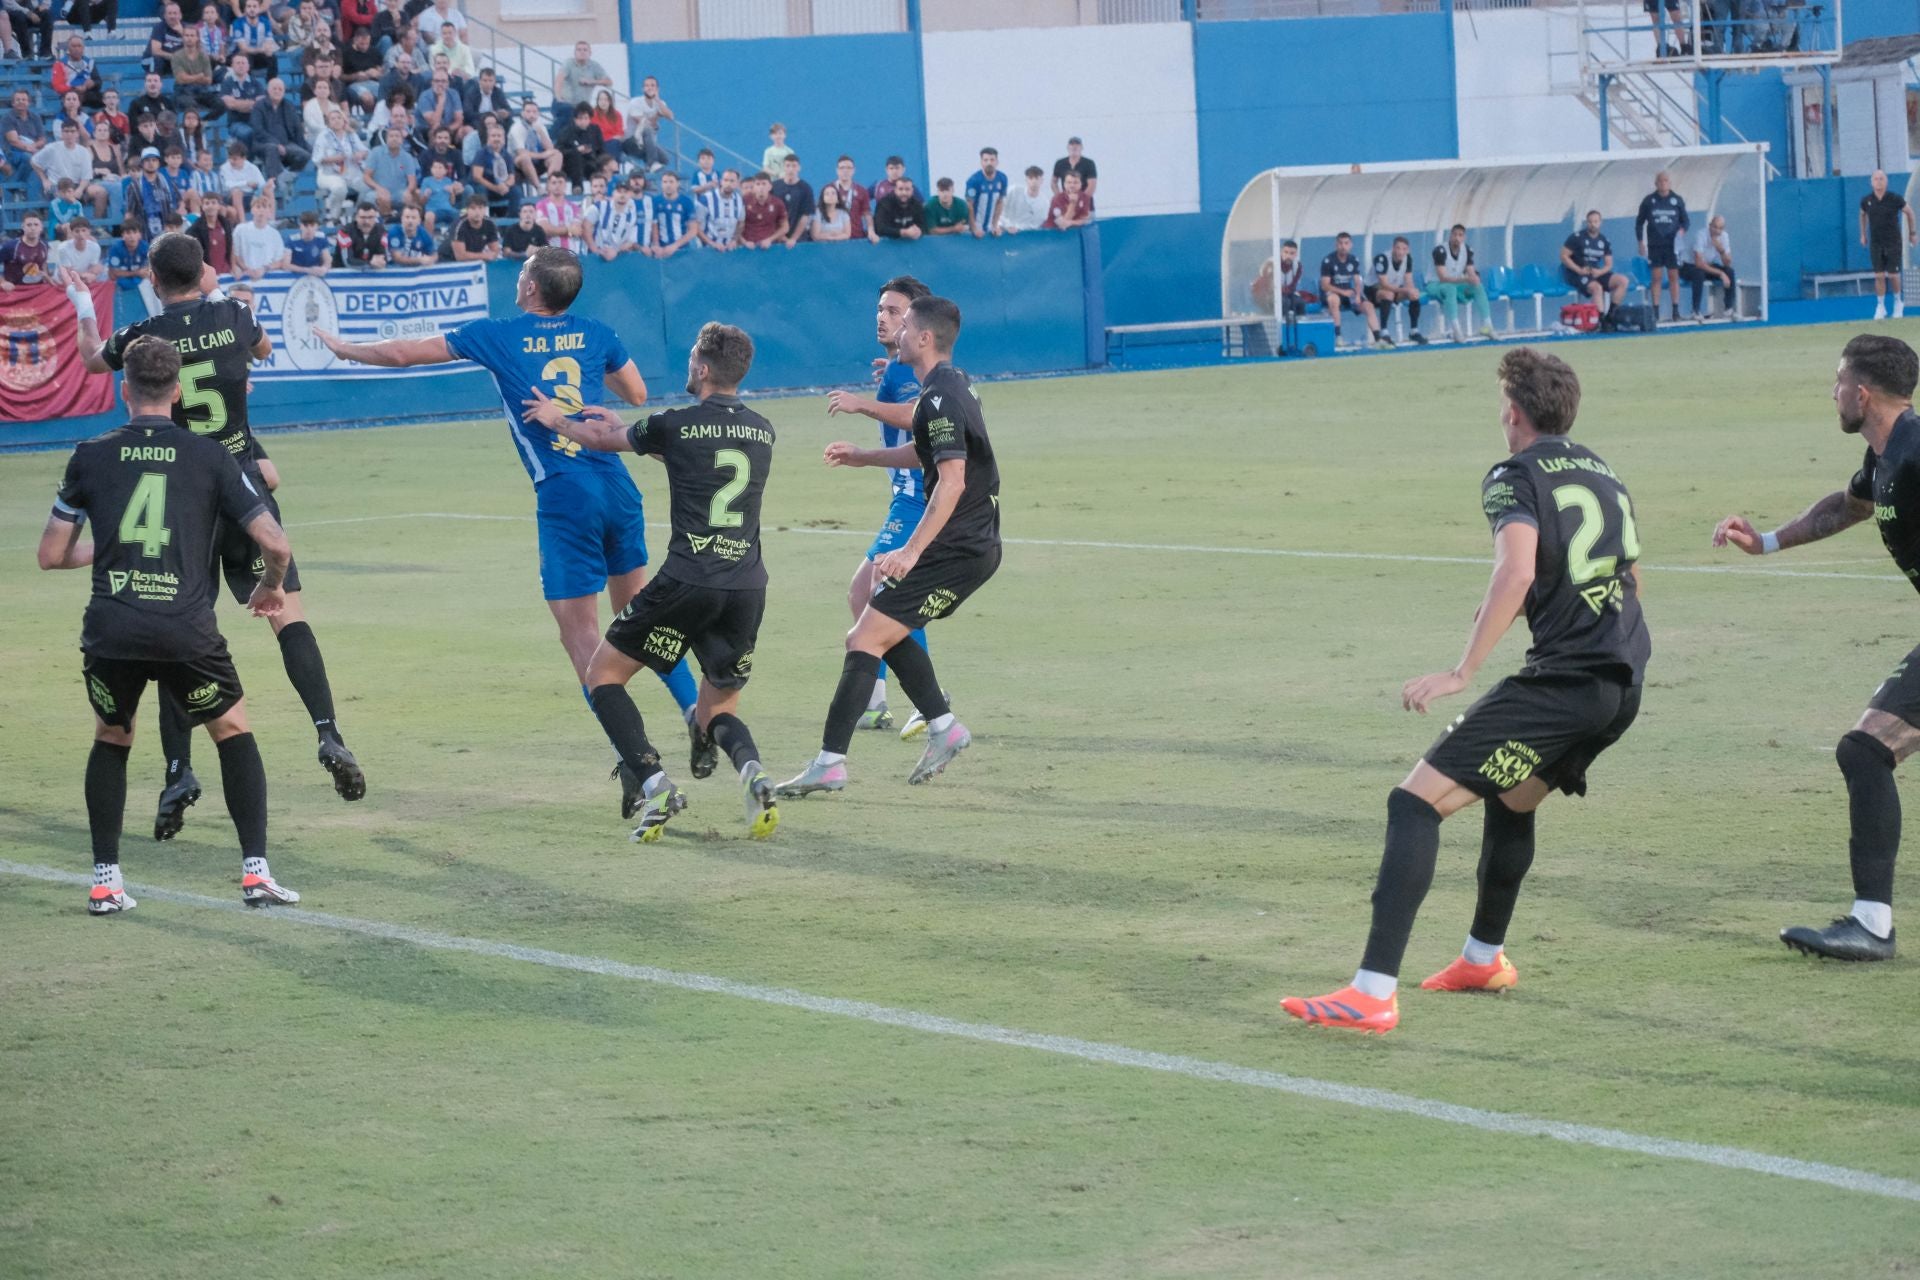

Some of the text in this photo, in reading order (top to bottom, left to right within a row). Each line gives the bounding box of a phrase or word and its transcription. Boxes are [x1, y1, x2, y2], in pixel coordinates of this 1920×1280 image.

[345, 288, 469, 312] DEPORTIVA
[402, 319, 435, 334] scala
[199, 328, 236, 350] CANO
[554, 332, 586, 351] RUIZ
[541, 356, 585, 415] 3
[178, 360, 229, 436] 5
[680, 425, 722, 439] SAMU
[120, 447, 176, 463] PARDO
[1537, 456, 1577, 473] LUIS
[708, 448, 751, 528] 2
[119, 473, 171, 558] 4
[1551, 483, 1641, 585] 21
[132, 569, 179, 585] Reynolds
[131, 581, 178, 595] Verdasco
[643, 643, 678, 663] FOODS
